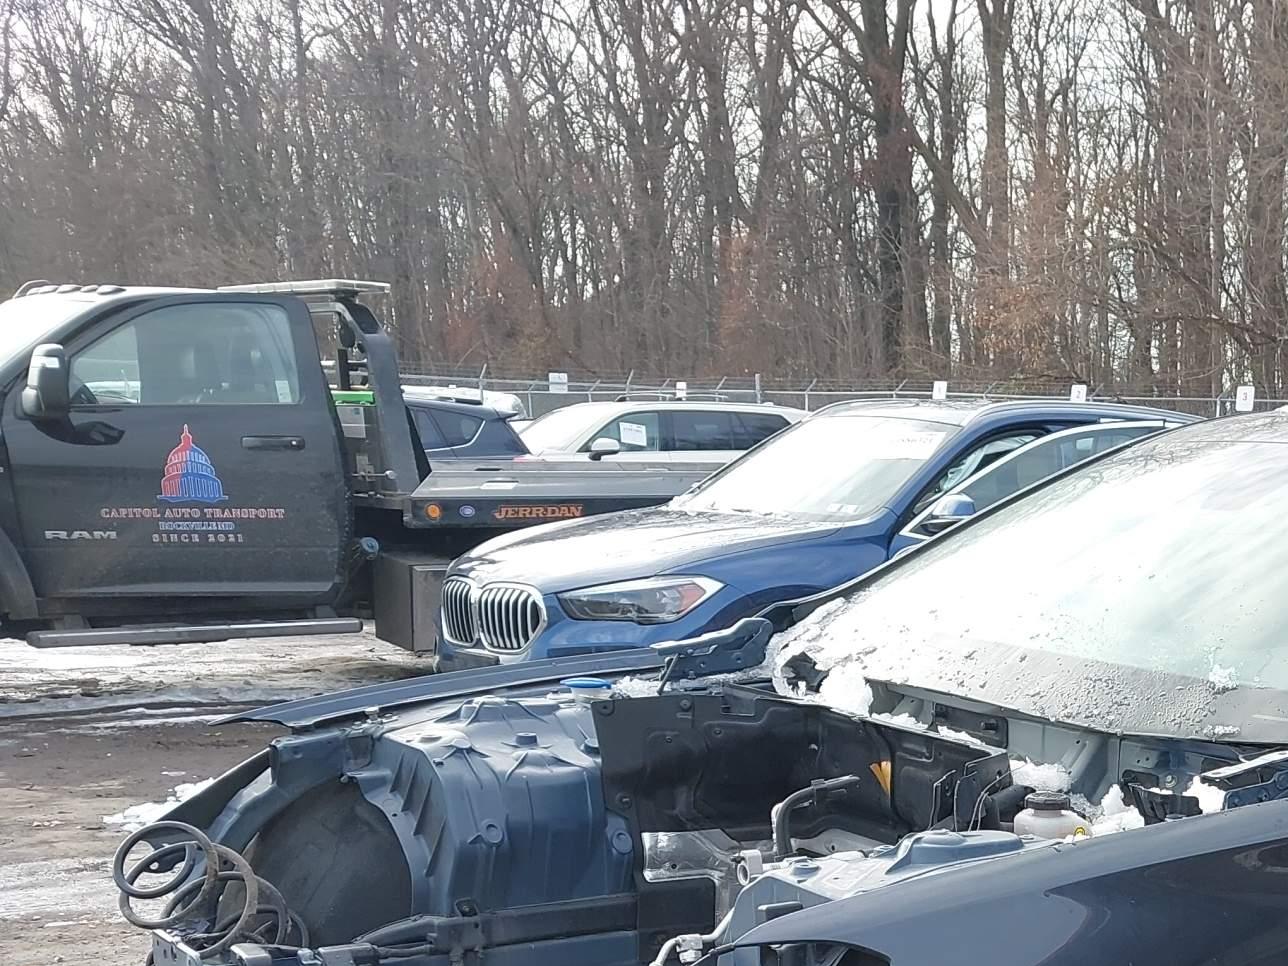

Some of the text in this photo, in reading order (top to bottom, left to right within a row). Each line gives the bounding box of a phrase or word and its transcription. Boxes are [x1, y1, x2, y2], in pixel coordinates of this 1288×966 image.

[100, 508, 285, 519] CAPITOL AUTO TRANSPORT
[44, 530, 118, 540] RAM
[152, 533, 244, 543] SINCE 2021
